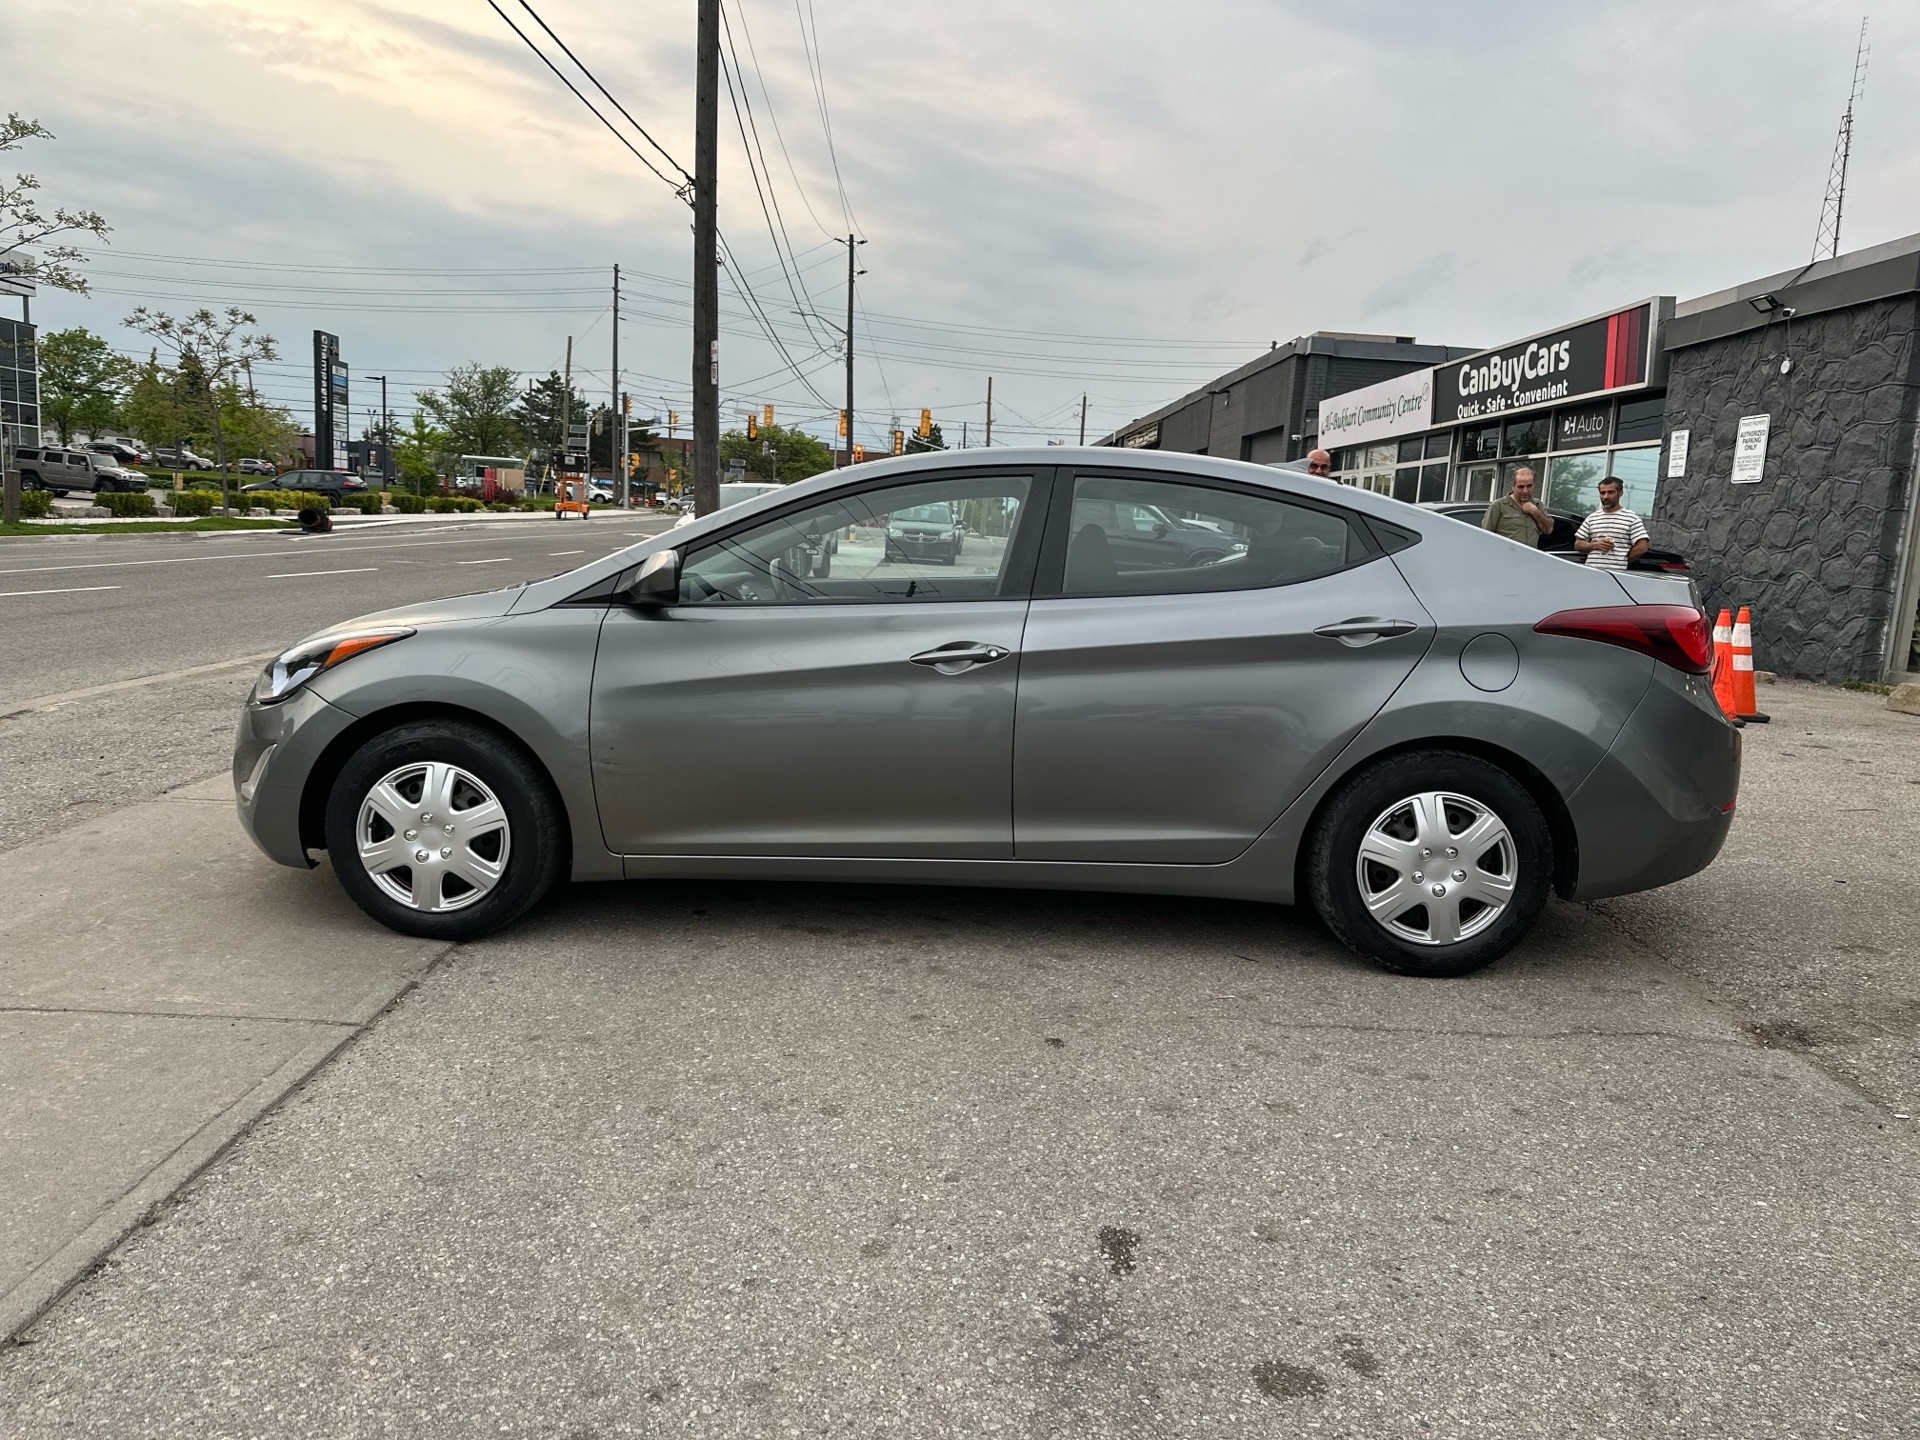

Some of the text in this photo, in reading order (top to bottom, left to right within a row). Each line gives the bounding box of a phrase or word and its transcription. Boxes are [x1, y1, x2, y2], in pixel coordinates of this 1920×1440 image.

[320, 335, 328, 412] Champagne
[1458, 340, 1570, 397] CanBuyCars
[1357, 398, 1397, 426] Community
[1397, 394, 1422, 417] Centre
[1457, 400, 1480, 419] Quick
[1486, 394, 1506, 413] Safe
[1513, 379, 1568, 408] Convenient
[1576, 413, 1604, 433] Auto
[1740, 430, 1766, 438] AUTHORIZED
[1742, 436, 1762, 444] PARKING
